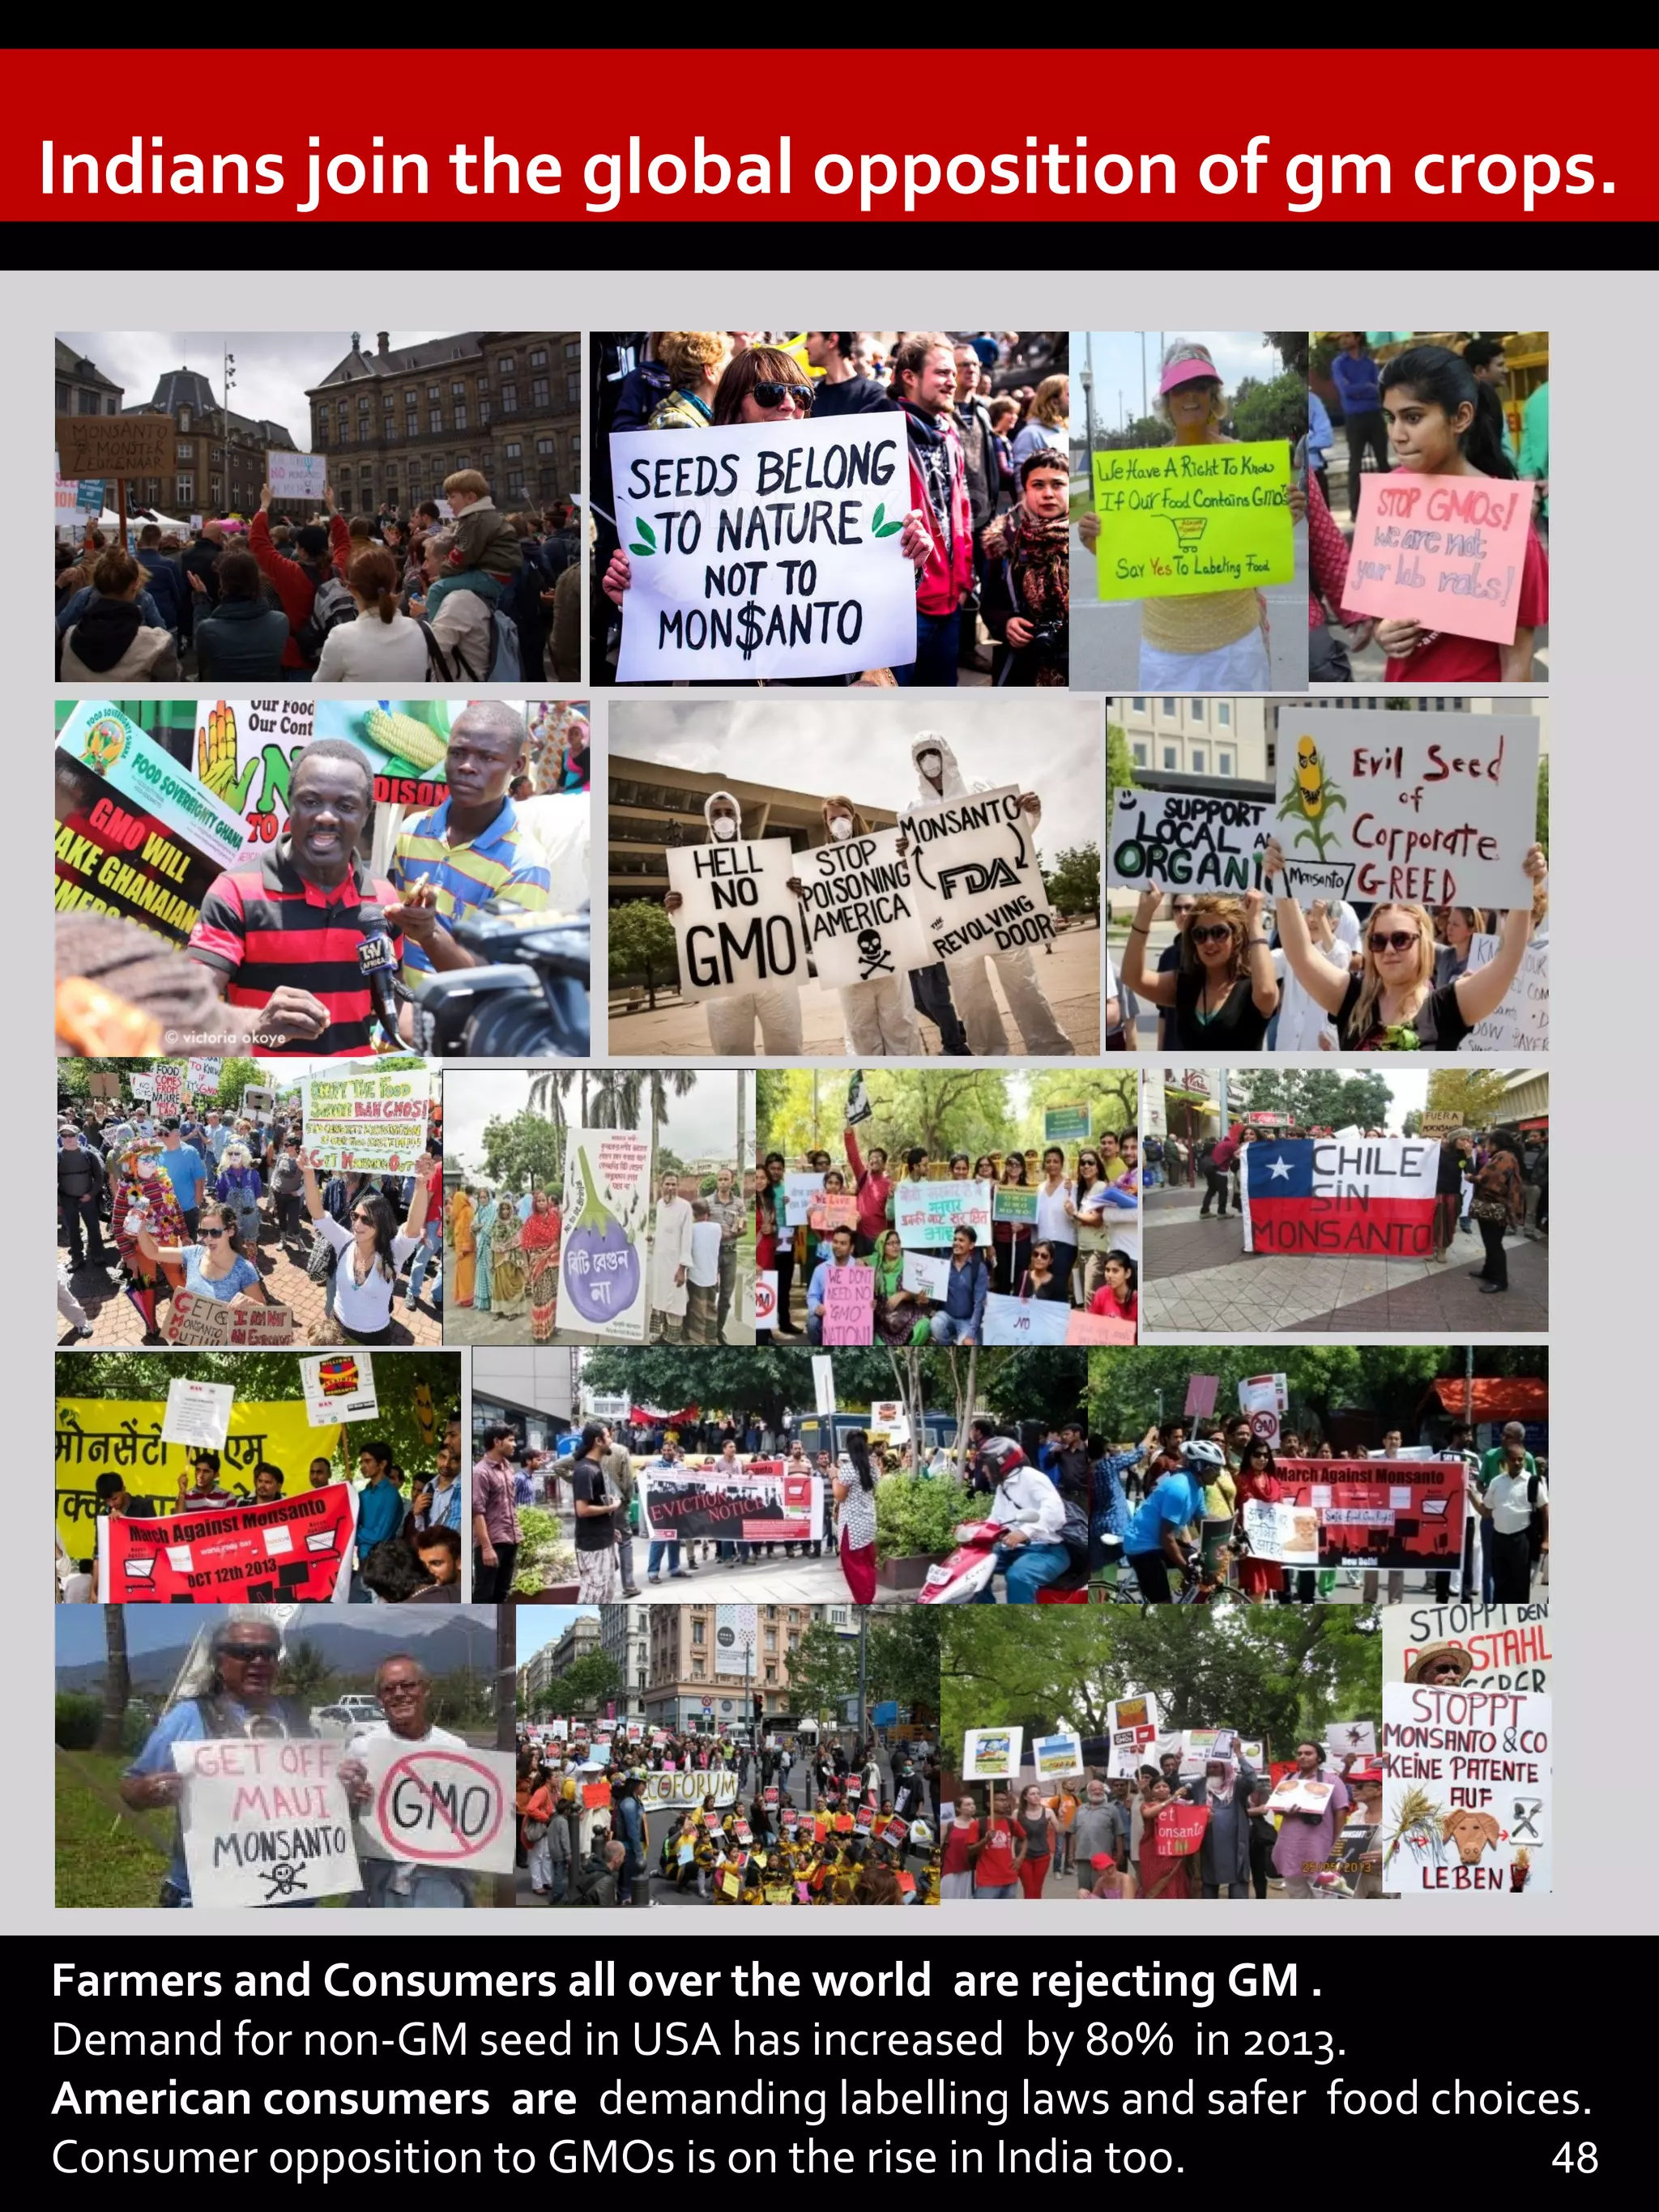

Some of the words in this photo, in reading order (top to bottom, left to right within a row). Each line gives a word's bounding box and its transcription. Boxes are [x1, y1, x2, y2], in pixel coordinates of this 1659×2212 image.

[72, 421, 168, 440] MONSANTO
[628, 452, 740, 499] SEEDS
[756, 439, 897, 496] BELONG
[1096, 459, 1124, 482] We
[1126, 458, 1161, 479] Have
[1164, 457, 1179, 478] A
[1180, 455, 1219, 478] Right
[1221, 458, 1238, 475] To
[1241, 456, 1275, 475] Know
[1099, 490, 1124, 511] If
[1162, 488, 1191, 509] Food
[1192, 488, 1250, 509] Contains
[1377, 488, 1422, 516] STOP
[1426, 488, 1519, 531] GMOs!
[655, 509, 702, 555] TO
[718, 500, 864, 552] NATURE
[1401, 531, 1442, 553] are
[1445, 528, 1486, 559] not
[705, 560, 767, 599] NOT
[776, 559, 817, 597] TO
[1115, 557, 1145, 579] Say
[1150, 557, 1173, 577] Yes
[1173, 555, 1188, 575] To
[1194, 554, 1241, 579] Labeling
[1245, 554, 1270, 573] Food
[1351, 559, 1390, 591] your
[1395, 555, 1426, 588] lab
[1438, 565, 1515, 607] rats!
[249, 713, 277, 733] Our
[1352, 746, 1403, 779] Evil
[1422, 734, 1505, 787] Seed
[131, 752, 162, 784] FOOD
[160, 775, 219, 829] SOVEREIGNTY
[215, 820, 244, 850] GHANA
[1163, 797, 1267, 827] SUPPORT
[1398, 786, 1424, 814] of
[898, 795, 1021, 845] MONSANTO
[1135, 811, 1241, 854] LOCAL
[89, 797, 147, 851] GMO
[141, 831, 191, 884] WILL
[1351, 811, 1501, 864] Corporate
[693, 845, 764, 880] HELL
[816, 839, 877, 876] STOP
[97, 855, 200, 935] GHANAIAN
[713, 877, 759, 910] NO
[802, 860, 911, 912] POISONING
[937, 856, 1021, 901] FDA
[1289, 867, 1345, 889] Monsanto
[1357, 863, 1457, 906] GREED
[812, 893, 911, 942] AMERICA
[932, 894, 1035, 959] REVOLVING
[994, 913, 1058, 951] DOOR
[363, 956, 386, 970] AFRICA
[684, 914, 798, 987] GMO
[155, 1074, 182, 1086] COMES
[156, 1063, 180, 1076] FOOD
[1426, 1111, 1459, 1121] FUERA
[1311, 1144, 1426, 1178] CHILE
[1252, 1220, 1433, 1253] MONSANTO
[589, 1281, 612, 1306] না
[827, 1269, 842, 1284] WE
[827, 1286, 850, 1301] NEED
[855, 1286, 871, 1301] NO
[1277, 1467, 1318, 1482] March
[1320, 1468, 1374, 1485] Against
[1376, 1468, 1445, 1485] Monsanto
[129, 1524, 169, 1544] March
[173, 1516, 239, 1543] Against
[243, 1498, 326, 1528] Monsanto
[650, 1492, 727, 1522] EVICTION
[708, 1497, 764, 1524] NOTICE
[188, 1572, 211, 1588] OCT
[215, 1565, 243, 1583] 12th
[245, 1558, 277, 1577] 2013
[1413, 1688, 1527, 1728] STOPPT
[1384, 1723, 1495, 1754] MONSANTO
[194, 1744, 266, 1777] GET
[280, 1744, 337, 1779] OFF
[1449, 1756, 1539, 1782] PATENTE
[232, 1784, 330, 1822] MAUI
[391, 1778, 490, 1838] GMO
[1450, 1788, 1492, 1809] AUF
[213, 1825, 347, 1869] MONSANTO
[1422, 1865, 1503, 1890] LEBEN
